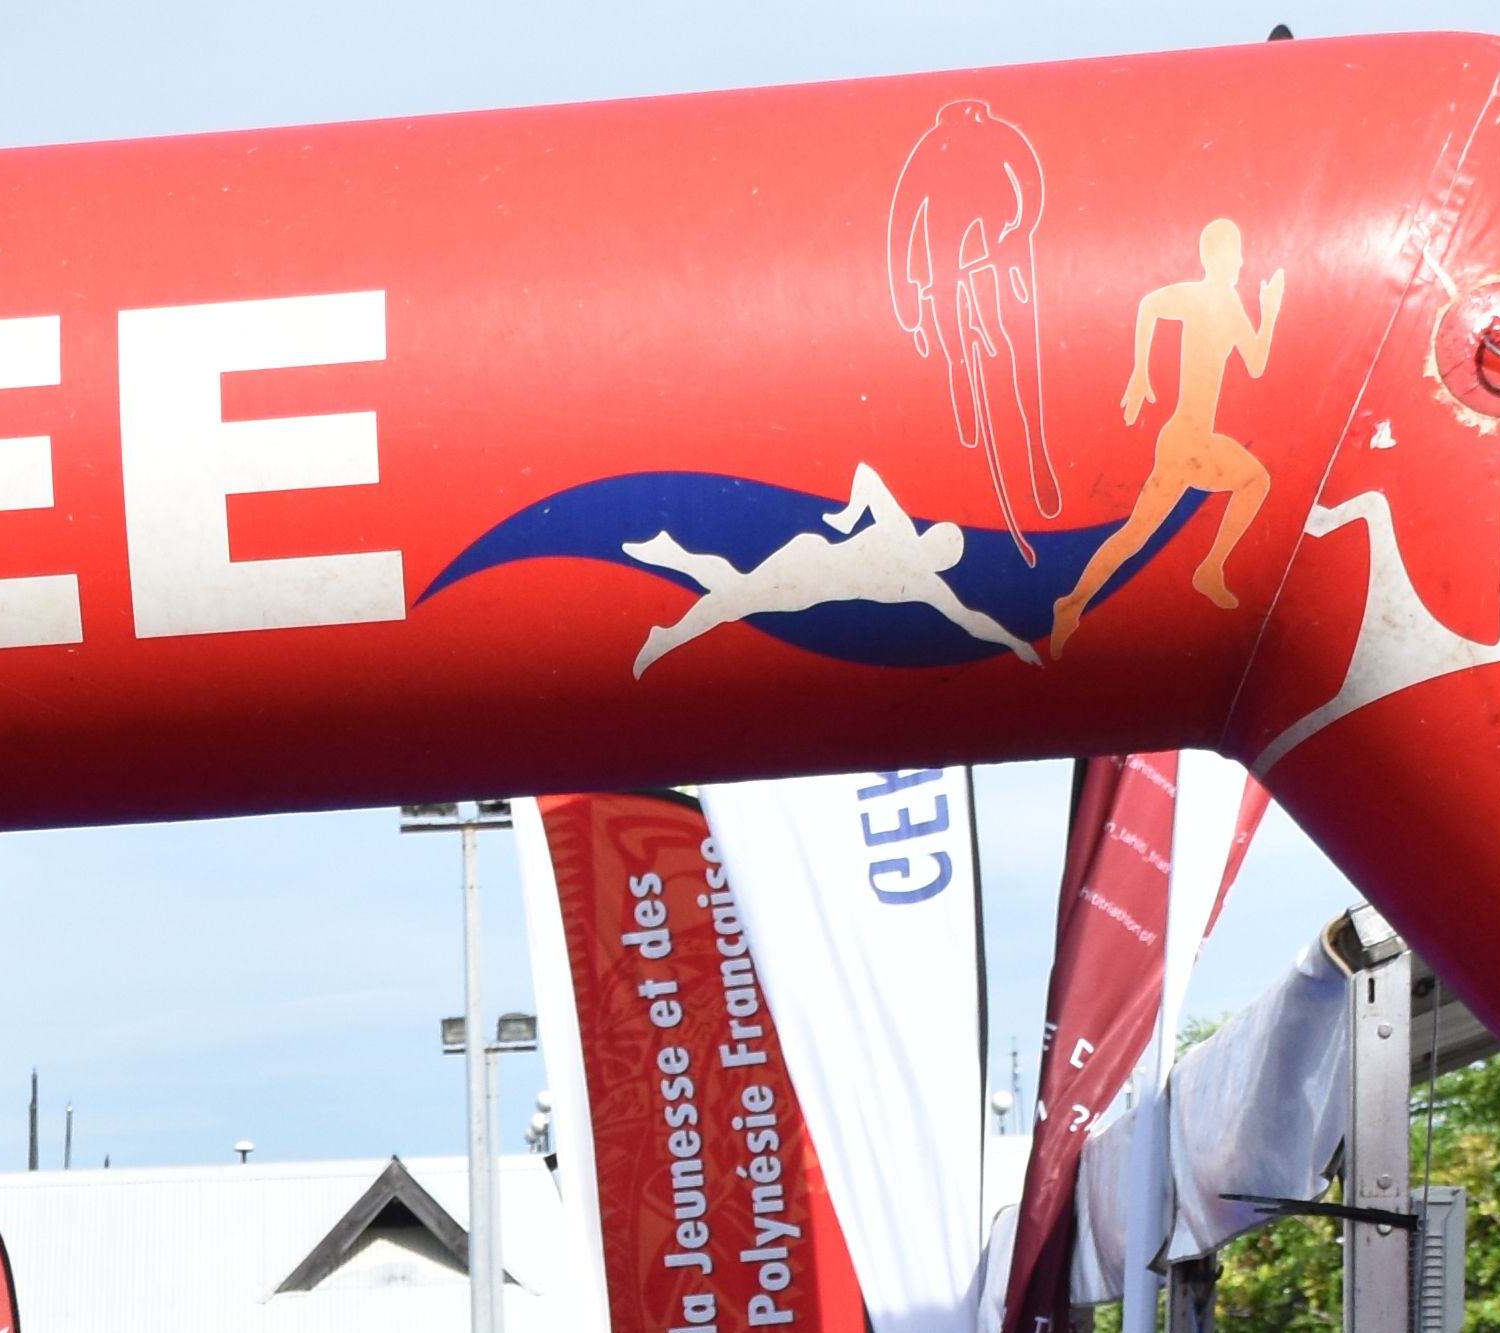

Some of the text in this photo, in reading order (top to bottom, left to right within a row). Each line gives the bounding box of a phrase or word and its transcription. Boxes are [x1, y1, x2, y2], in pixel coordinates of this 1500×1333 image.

[622, 871, 673, 960] des
[638, 979, 683, 1028] et
[657, 1046, 713, 1275] Jeunesse
[732, 1084, 801, 1327] Polynésie
